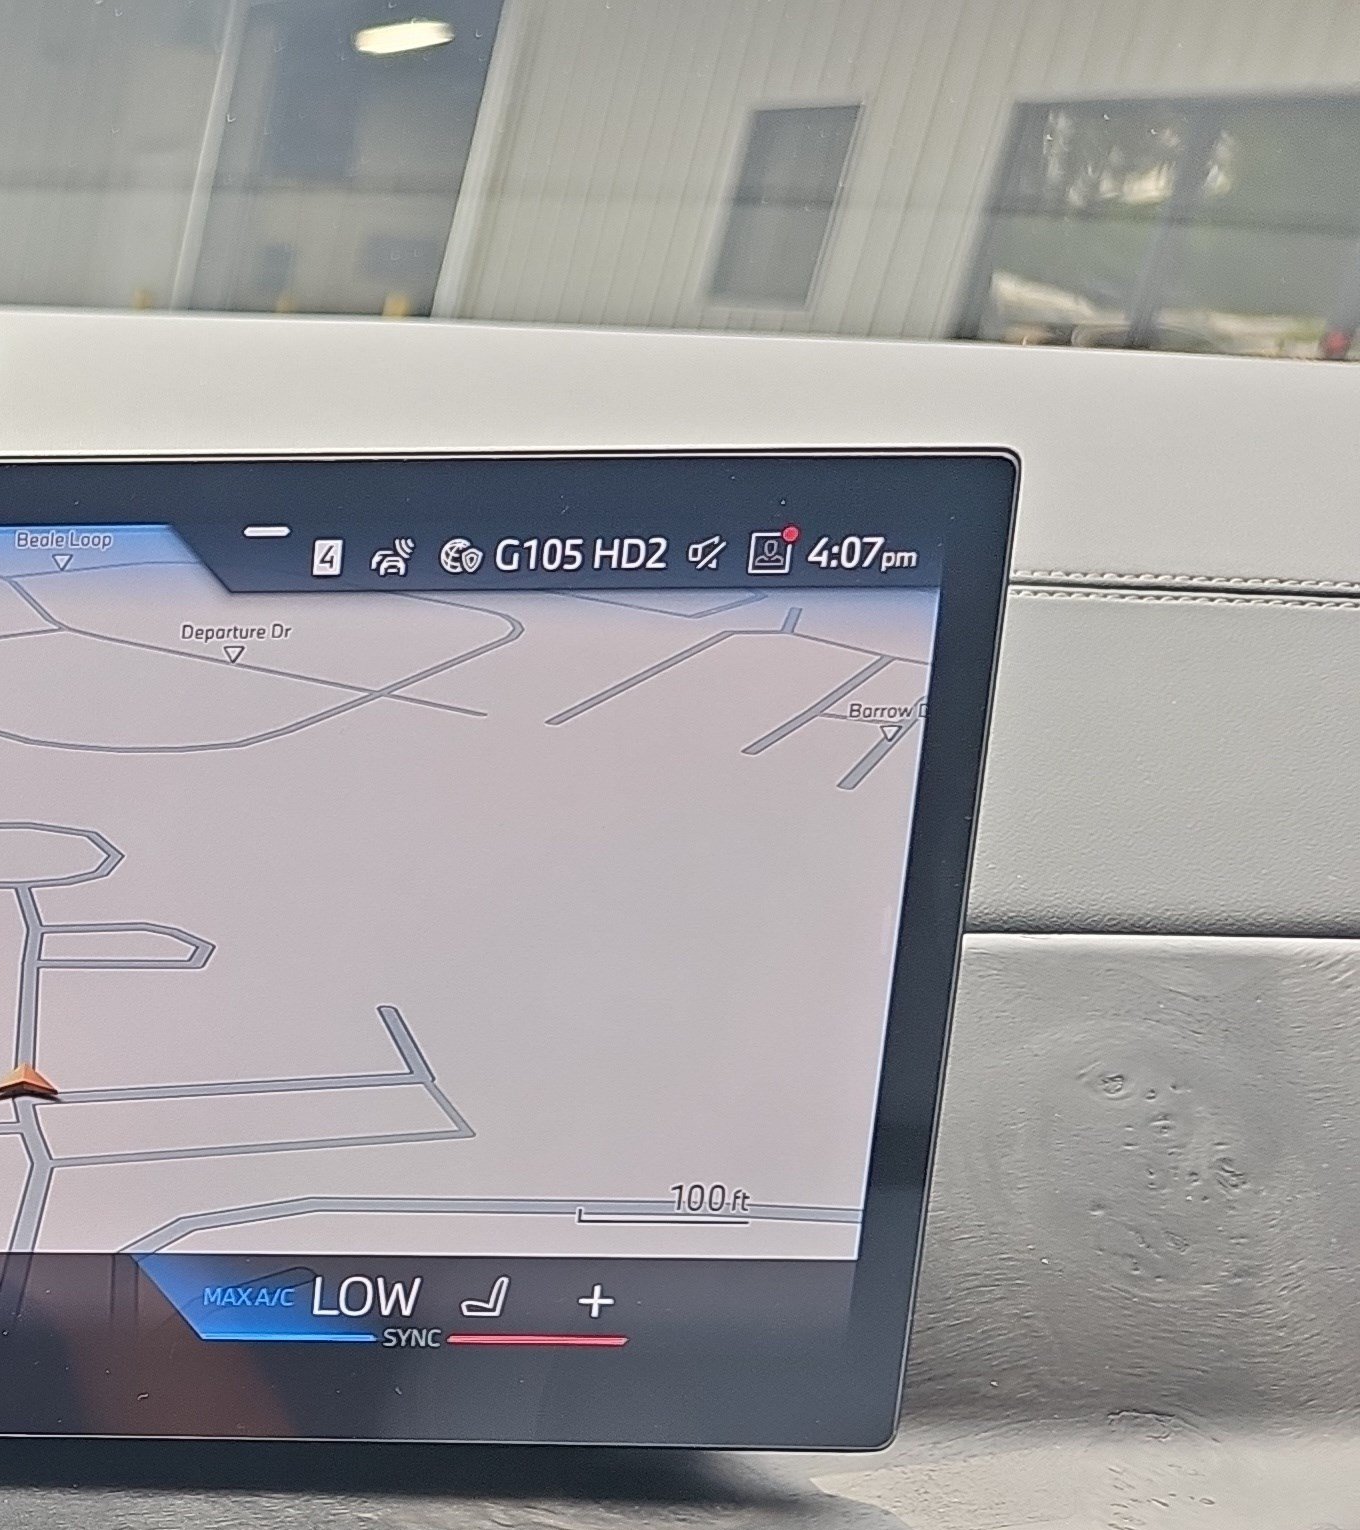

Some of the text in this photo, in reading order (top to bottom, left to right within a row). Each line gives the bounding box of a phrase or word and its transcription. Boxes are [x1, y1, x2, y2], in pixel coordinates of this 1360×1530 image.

[15, 531, 112, 552] Beale Loop
[318, 545, 335, 570] 4
[495, 538, 667, 572] G105 HD2
[181, 624, 293, 642] Departure Dr
[849, 703, 913, 719] Barrow
[671, 1183, 751, 1214] 100 ft
[202, 1286, 295, 1307] MAX A/C
[310, 1275, 423, 1318] LOW
[382, 1327, 442, 1349] SYNC
